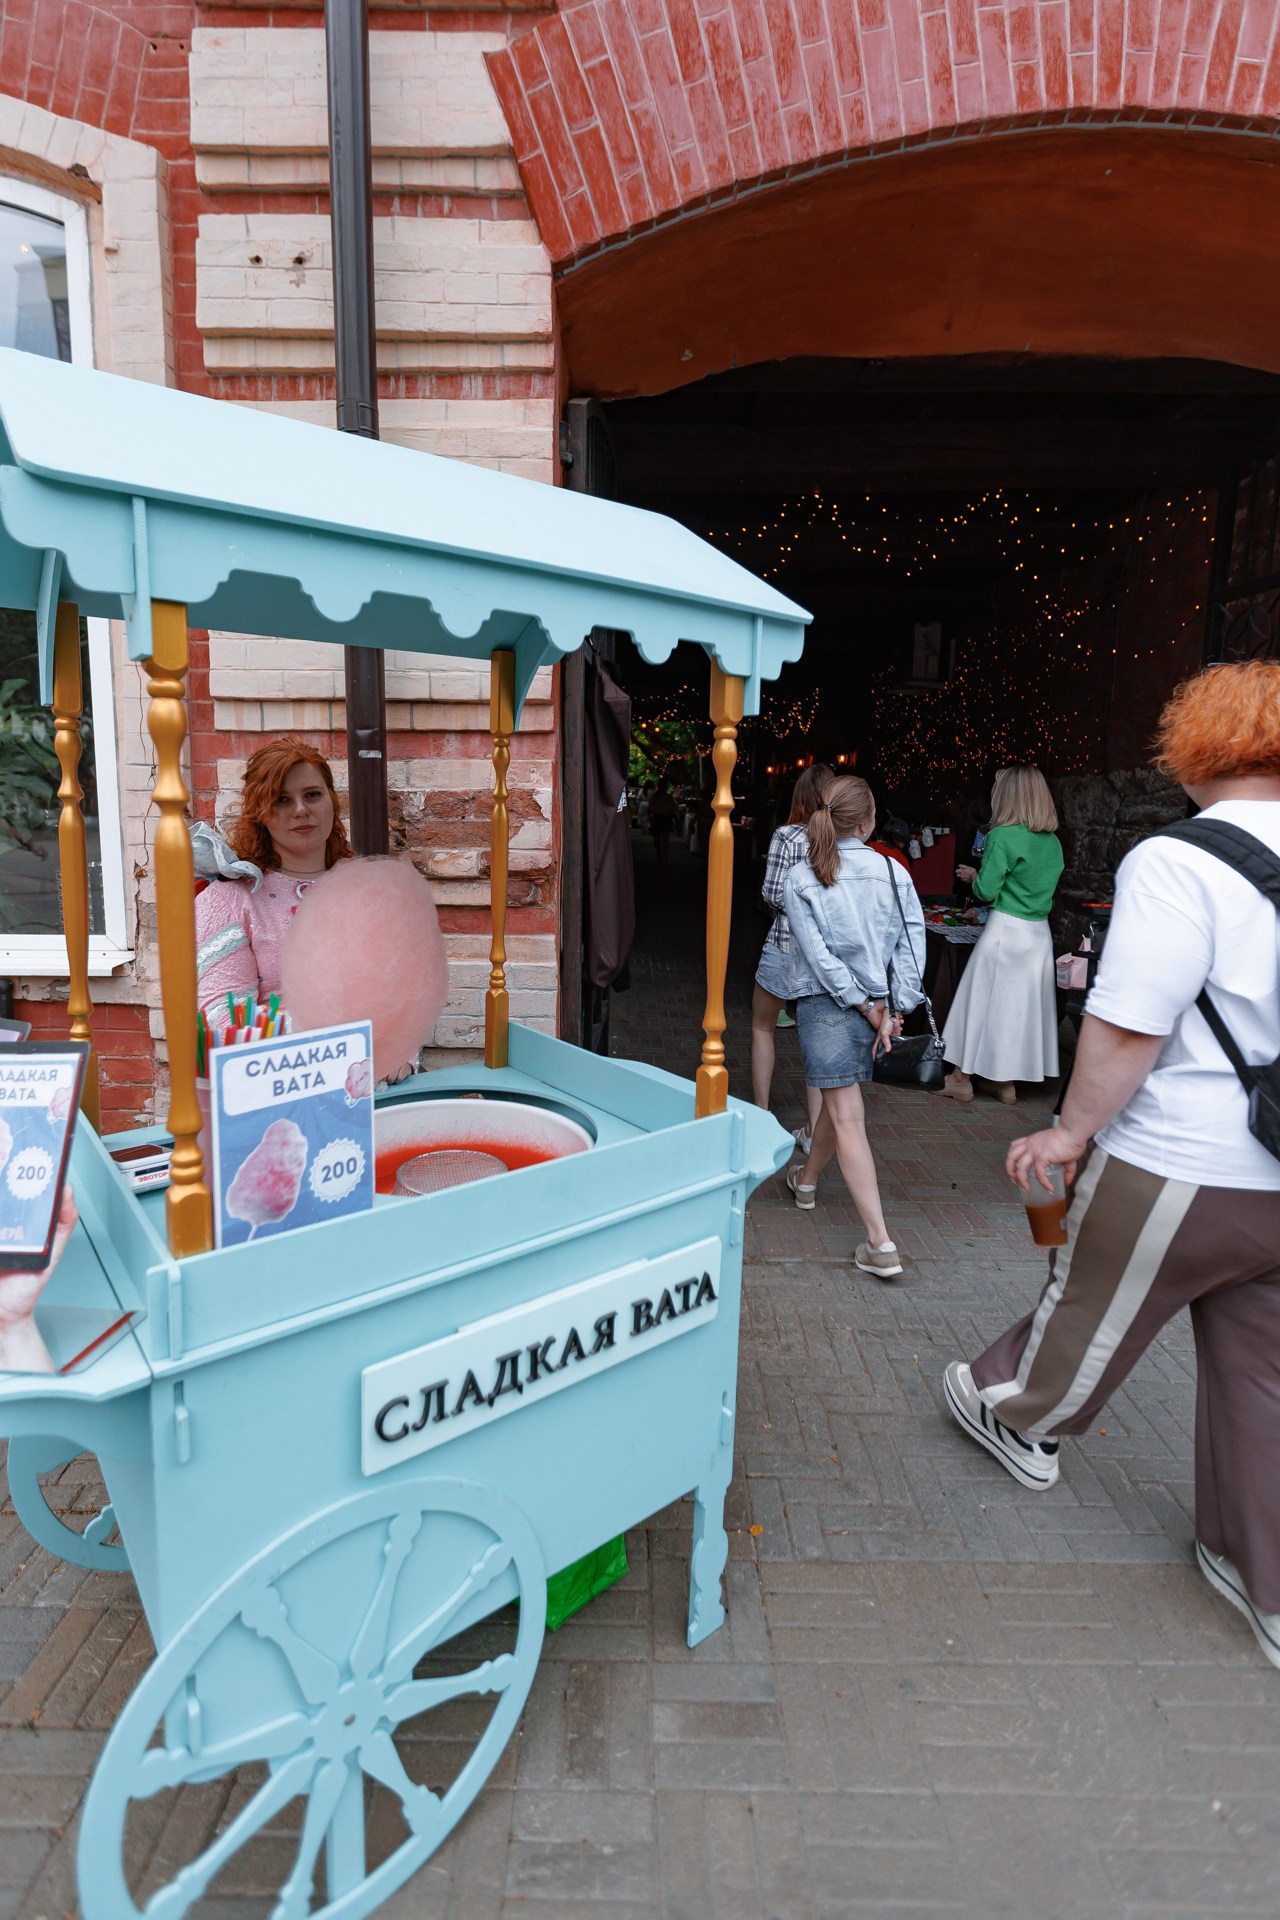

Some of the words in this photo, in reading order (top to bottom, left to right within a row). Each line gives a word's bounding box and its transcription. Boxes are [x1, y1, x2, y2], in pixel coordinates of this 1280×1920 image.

[245, 1041, 348, 1078] СЛАДКАЯ
[272, 1070, 326, 1097] ВАТА
[16, 1166, 47, 1180] 200
[321, 1157, 357, 1184] 200
[374, 1310, 618, 1443] СЛАДКАЯ
[629, 1271, 719, 1337] ВАТА
